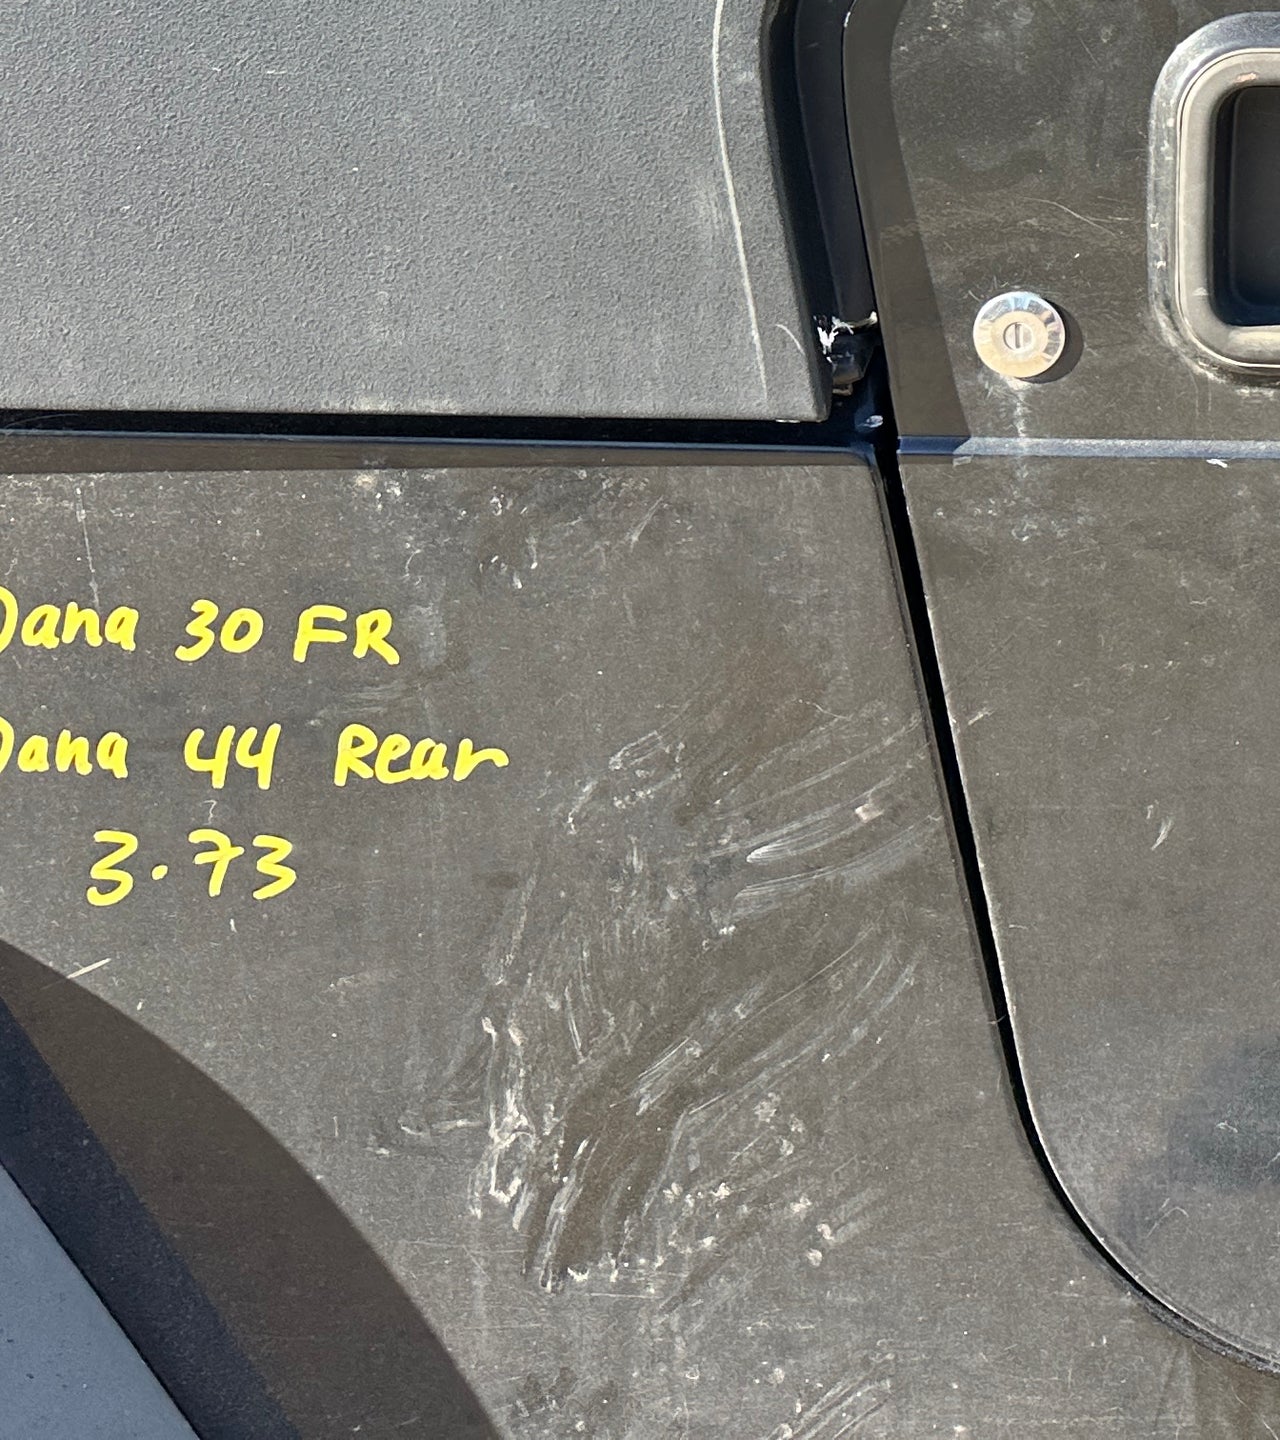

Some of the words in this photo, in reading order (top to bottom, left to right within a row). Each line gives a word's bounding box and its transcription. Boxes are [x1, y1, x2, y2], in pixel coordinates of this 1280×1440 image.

[174, 598, 264, 661] 30
[292, 603, 400, 665] FR
[183, 723, 282, 789] 44
[332, 722, 510, 786] Rear
[86, 827, 297, 906] 3.73
